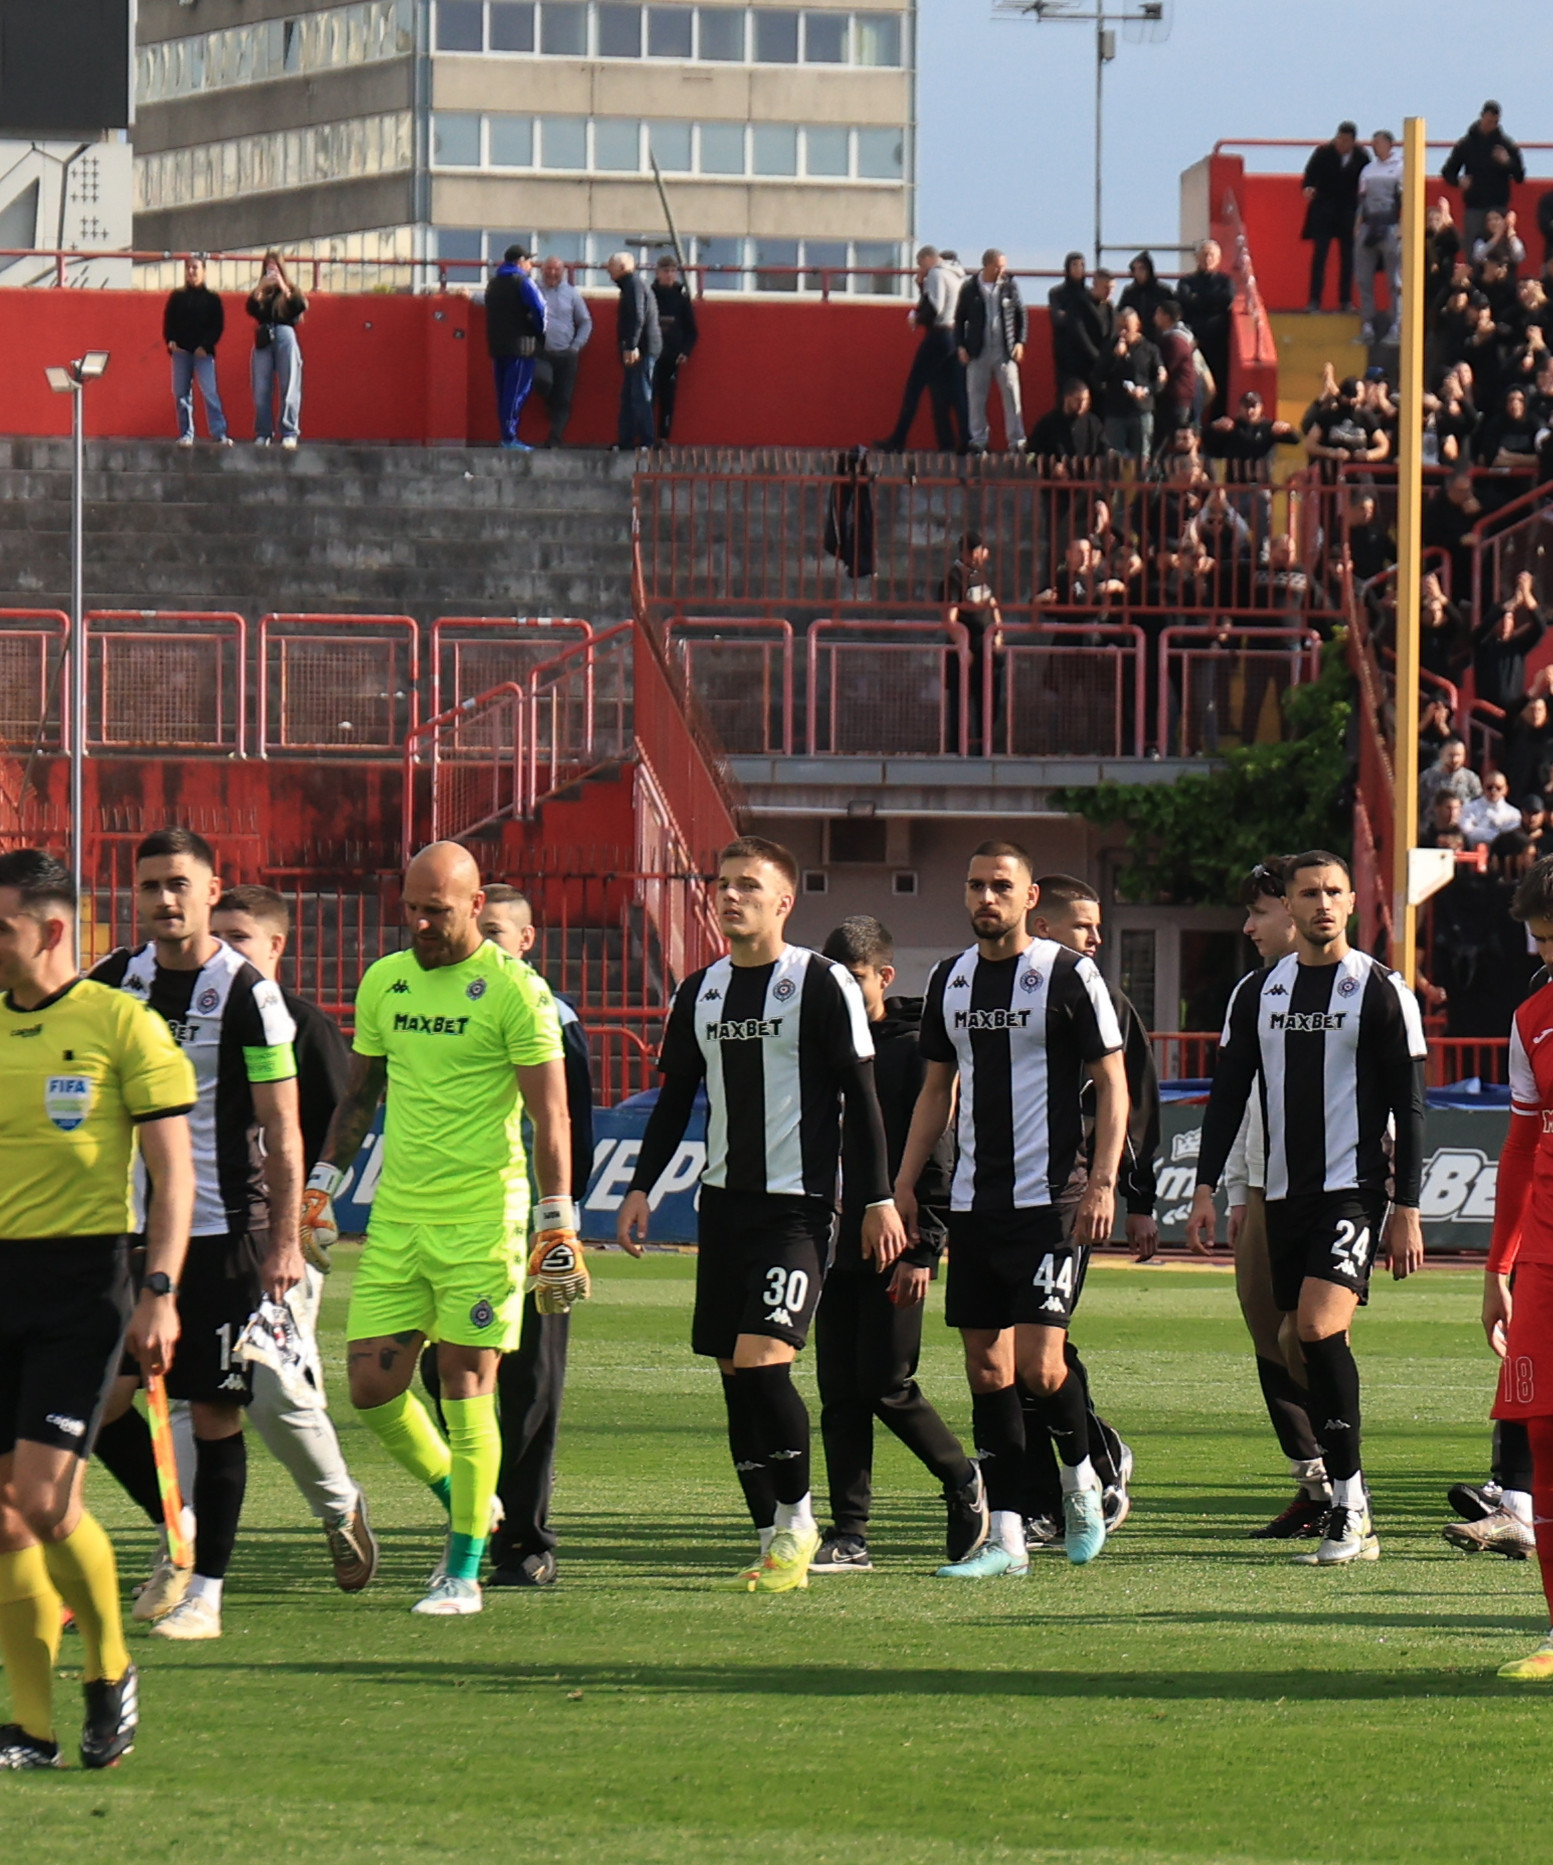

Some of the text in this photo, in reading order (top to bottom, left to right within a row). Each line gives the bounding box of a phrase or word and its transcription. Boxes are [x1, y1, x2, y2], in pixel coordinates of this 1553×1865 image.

[393, 1013, 470, 1035] MAXBET
[705, 1017, 784, 1040] MAXBET
[954, 1009, 1032, 1029] MAXBET
[1270, 1012, 1348, 1031] MAXBET
[49, 1079, 86, 1093] FIFA
[1331, 1220, 1370, 1261] 24
[1033, 1253, 1073, 1299] 44
[763, 1267, 808, 1312] 30
[1503, 1355, 1534, 1403] 18
